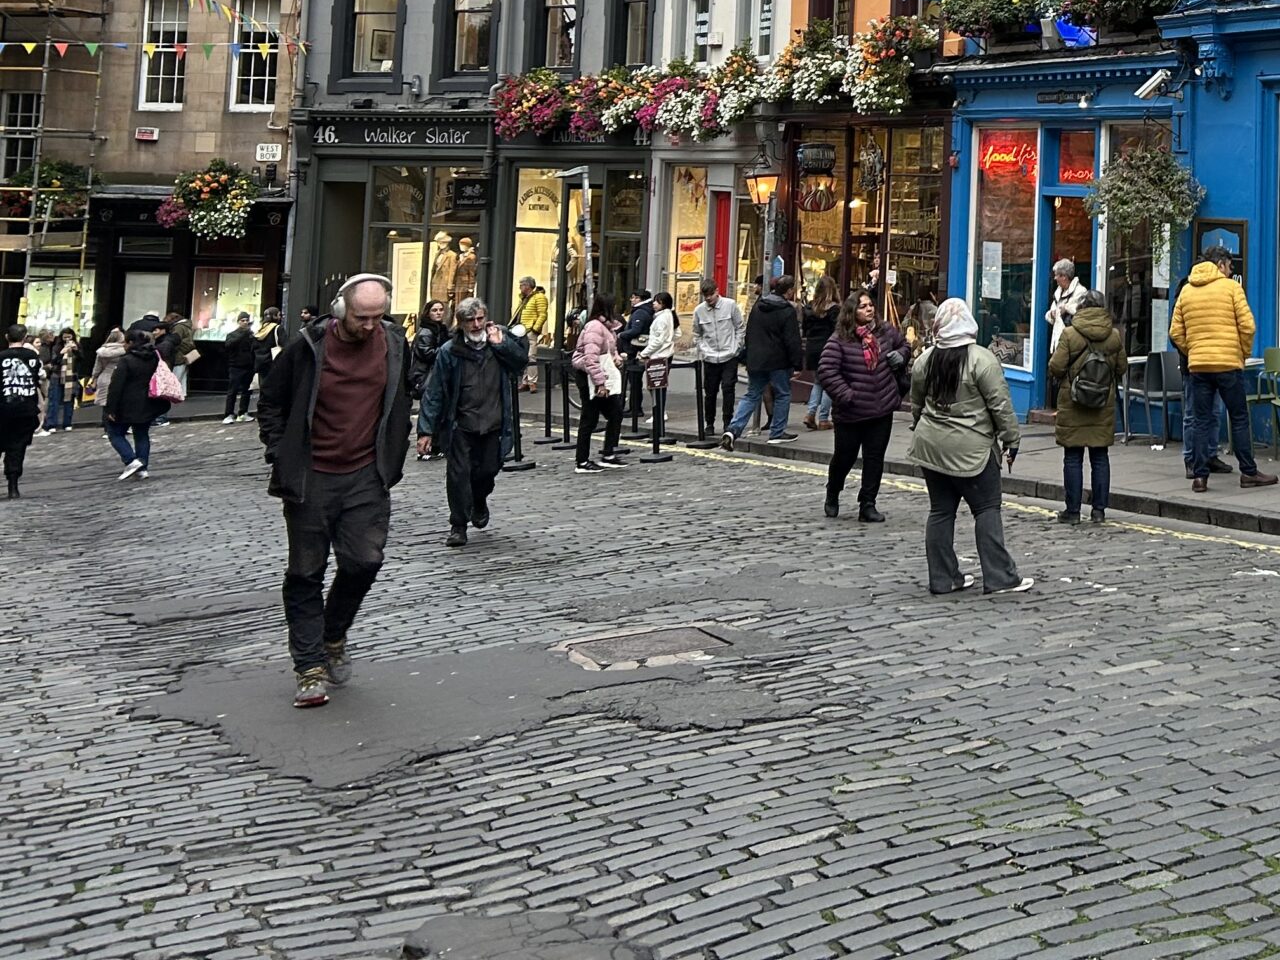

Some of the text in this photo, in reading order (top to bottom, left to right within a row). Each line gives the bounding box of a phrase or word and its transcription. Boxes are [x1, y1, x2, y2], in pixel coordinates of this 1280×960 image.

[364, 125, 416, 144] Walker
[425, 125, 471, 144] Slater
[259, 145, 280, 153] WEST
[260, 152, 278, 160] BOW
[983, 145, 1017, 168] food
[519, 187, 534, 206] LADIES
[528, 203, 549, 211] KNITWEAR
